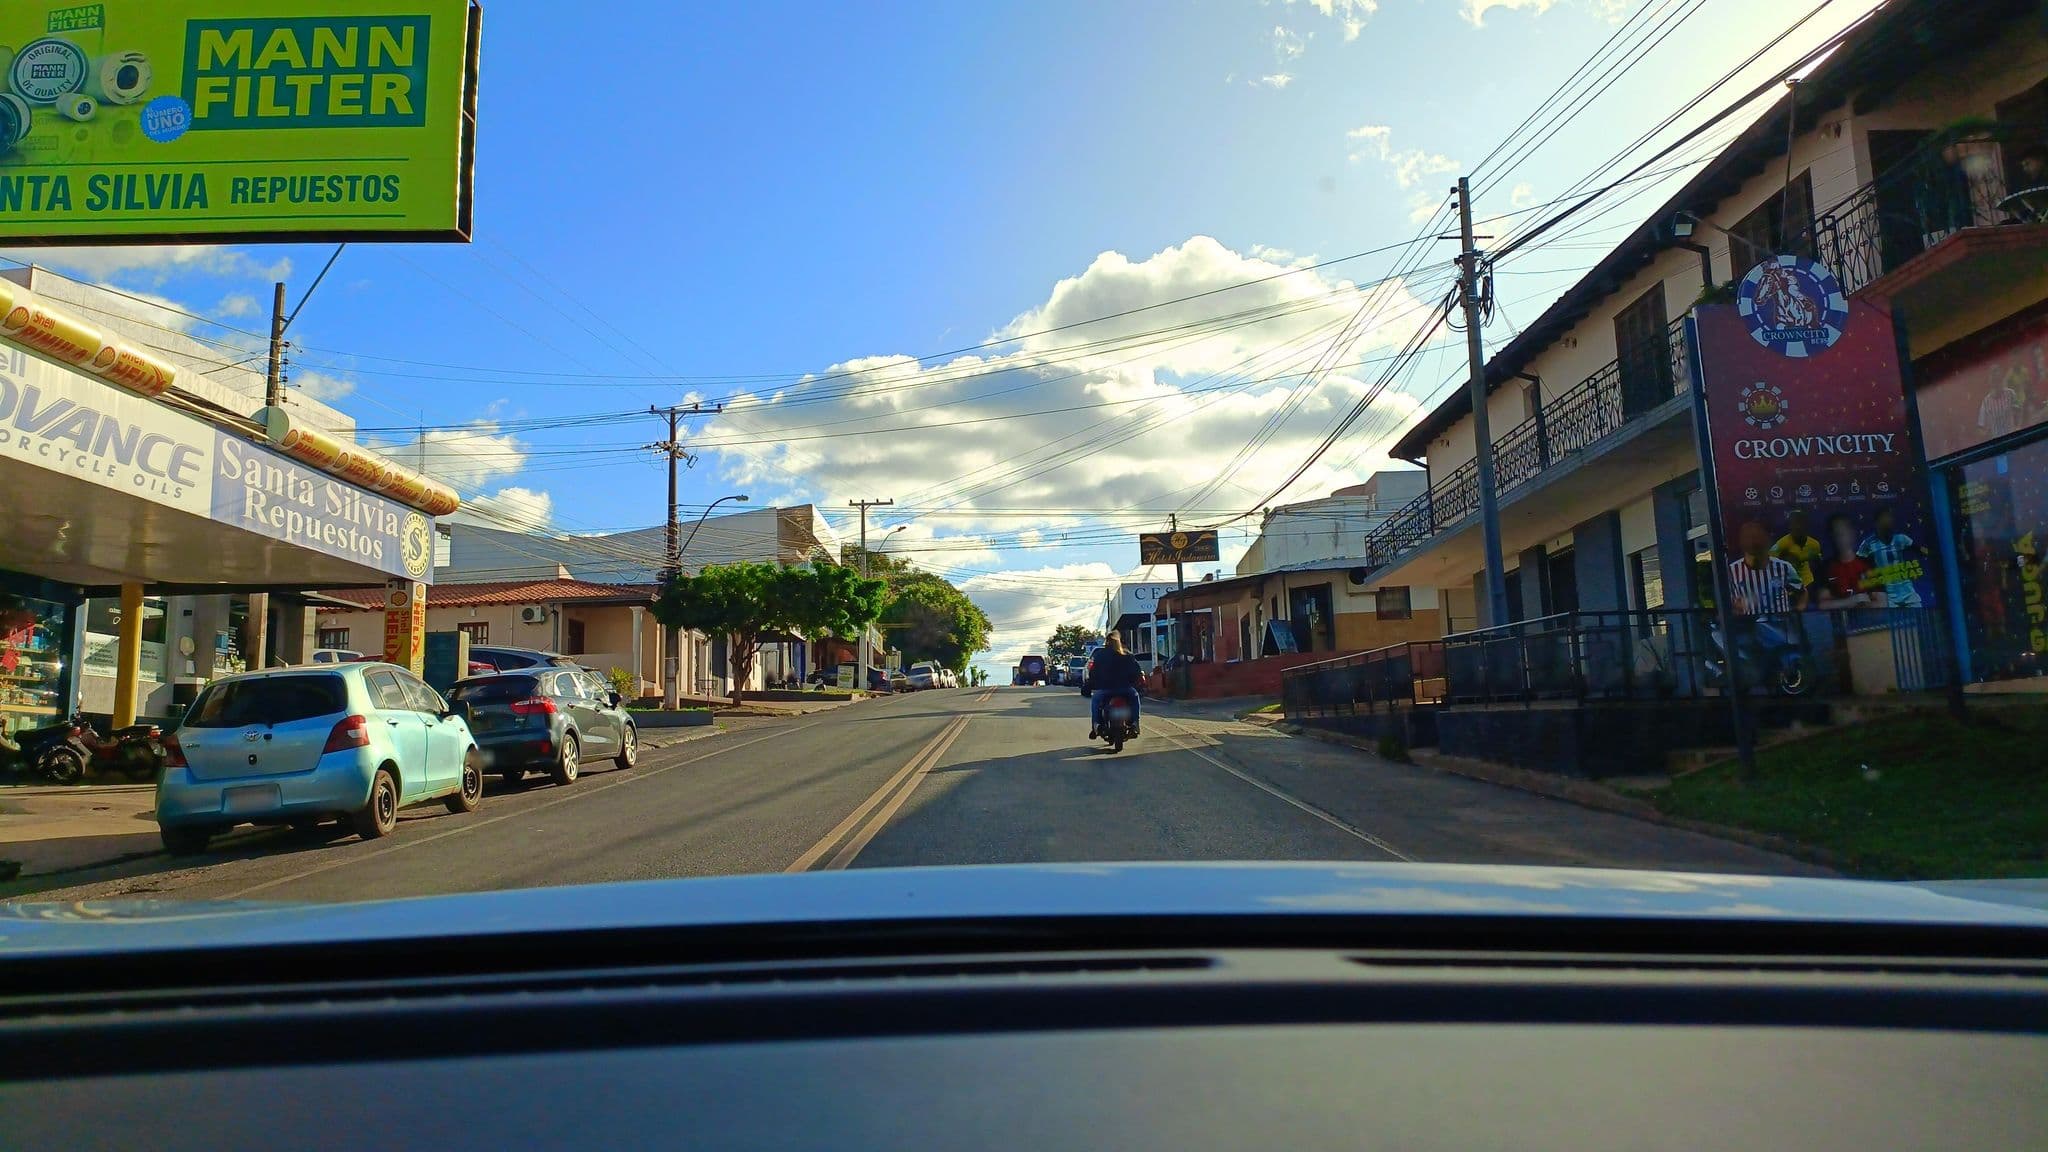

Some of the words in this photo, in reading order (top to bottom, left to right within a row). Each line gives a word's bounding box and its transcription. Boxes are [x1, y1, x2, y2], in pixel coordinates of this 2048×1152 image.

[50, 6, 99, 21] MANN
[50, 16, 98, 31] FILTER
[28, 45, 72, 60] ORIGINAL
[198, 26, 414, 71] MANN
[23, 80, 34, 90] OF
[35, 79, 72, 97] QUALITY
[194, 73, 414, 119] FILTER
[148, 112, 184, 131] UNO
[86, 173, 208, 211] SILVIA
[231, 174, 400, 204] REPUESTOS
[33, 311, 56, 330] Shell
[1763, 328, 1827, 341] CROWNCITY
[1734, 433, 1896, 460] CROWNCITY
[133, 473, 182, 499] OILS
[220, 438, 315, 508] Santa
[325, 480, 398, 538] Silvia
[243, 485, 383, 560] Repuestos
[384, 610, 400, 662] HELIX
[411, 602, 421, 657] HELIX
